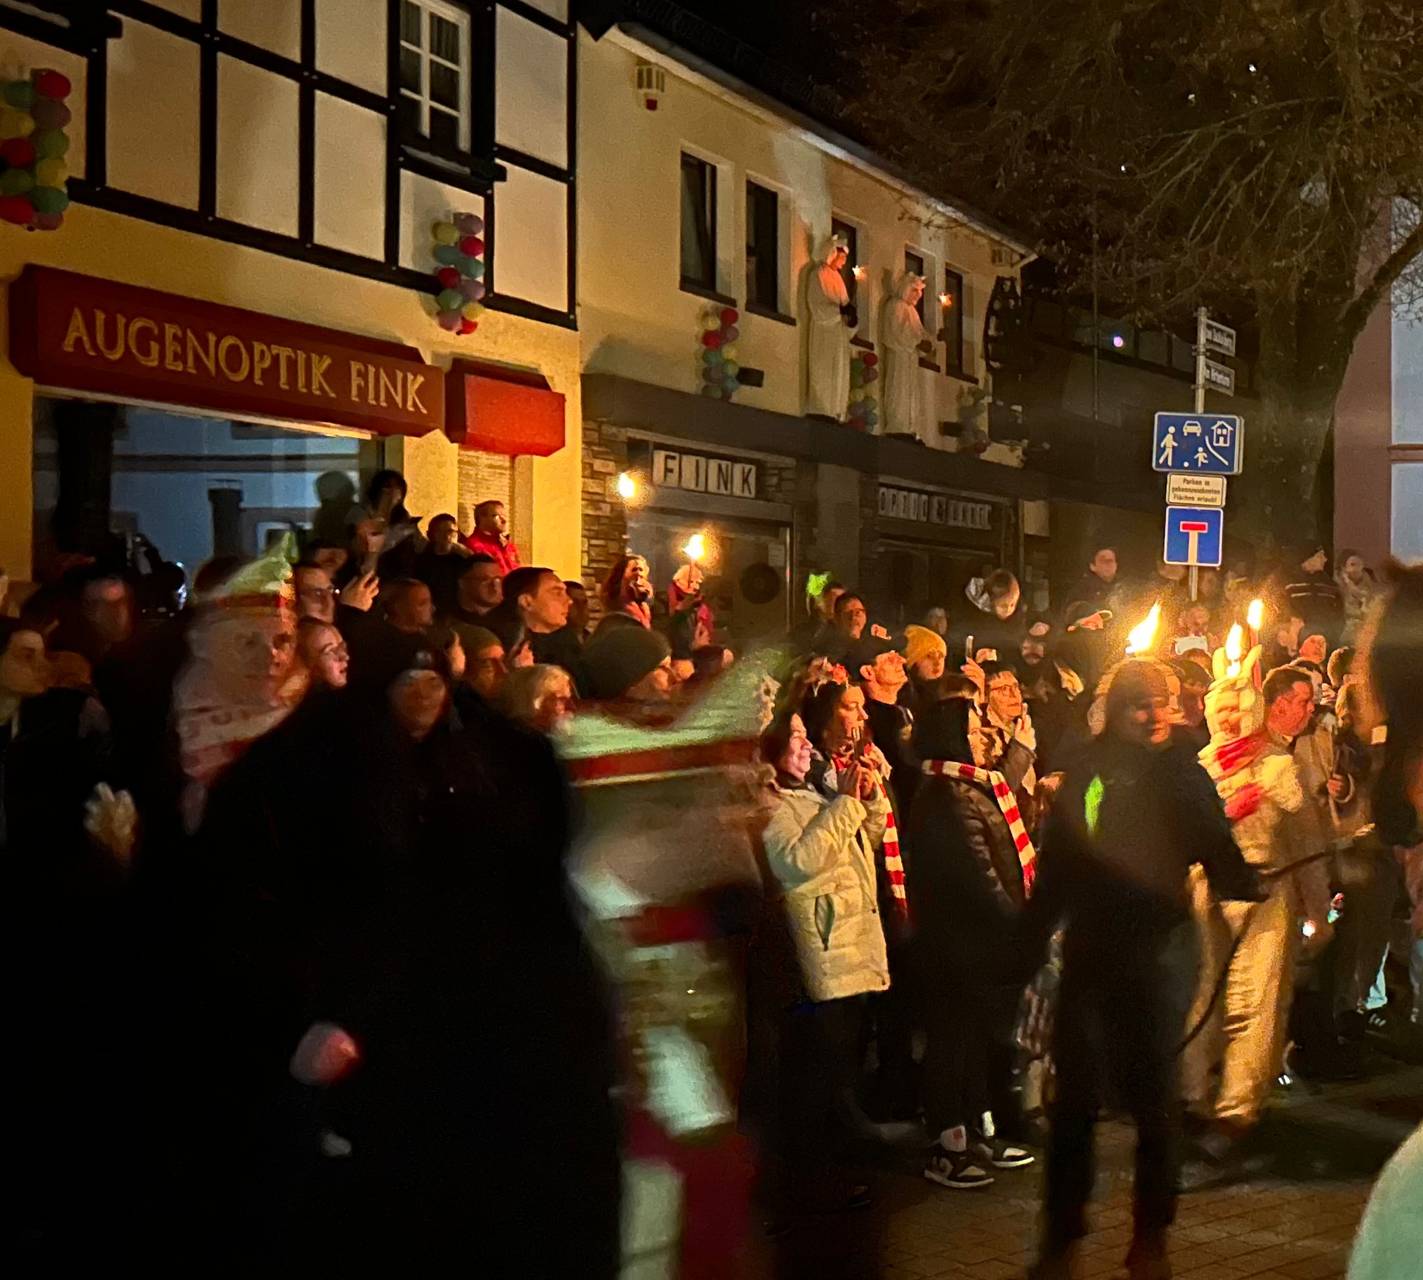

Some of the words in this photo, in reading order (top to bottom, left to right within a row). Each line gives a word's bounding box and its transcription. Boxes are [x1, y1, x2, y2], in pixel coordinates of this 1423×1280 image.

[62, 307, 337, 398] AUGENOPTIK
[349, 359, 428, 415] FINK
[663, 454, 752, 495] FINK
